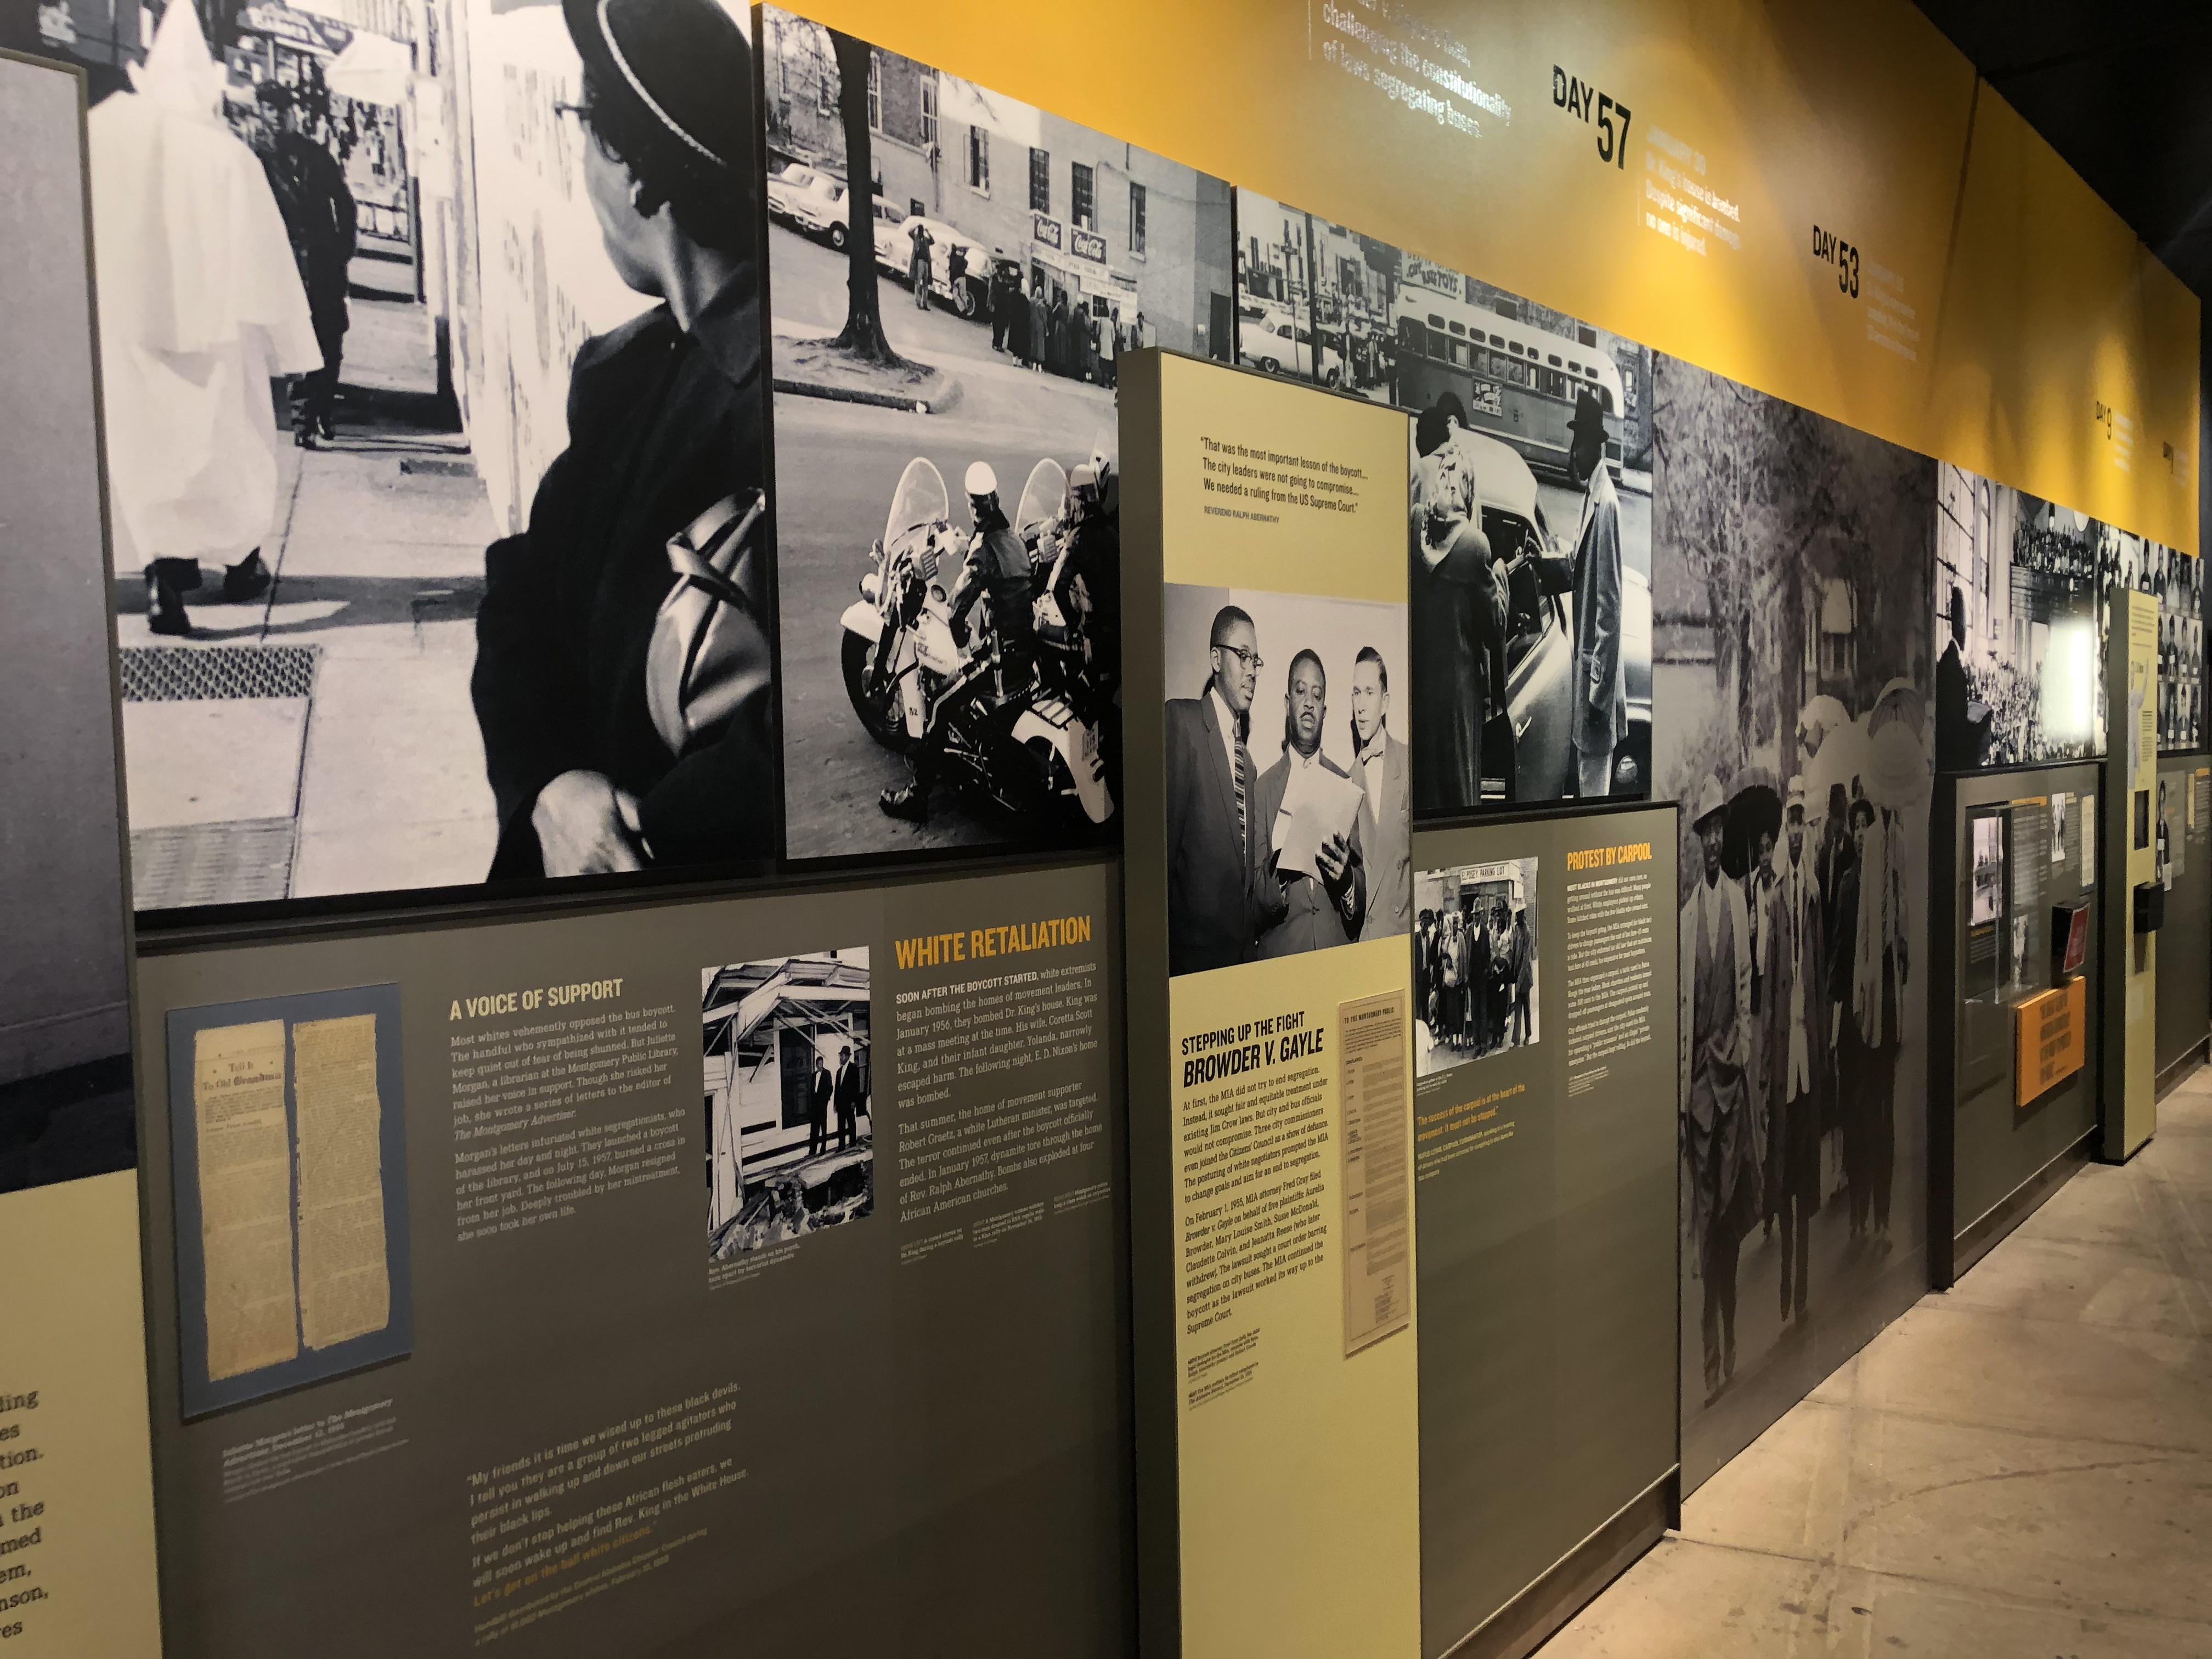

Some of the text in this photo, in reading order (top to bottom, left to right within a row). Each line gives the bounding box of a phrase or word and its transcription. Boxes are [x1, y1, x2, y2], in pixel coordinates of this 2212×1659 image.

[1553, 64, 1594, 123] DAY
[1597, 93, 1631, 170] 57
[1813, 225, 1859, 298] DAY 53
[2107, 407, 2112, 441] 9
[1201, 437, 1220, 452] "That
[1222, 444, 1235, 455] was
[1237, 444, 1248, 458] the
[1250, 449, 1266, 460] most
[1268, 451, 1299, 466] important
[1301, 456, 1320, 470] lesson
[1322, 461, 1328, 472] of
[1329, 462, 1339, 474] the
[1204, 457, 1216, 471] The
[1218, 463, 1231, 476] city
[1233, 462, 1257, 478] leaders
[1260, 471, 1275, 482] were
[1278, 474, 1288, 483] not
[1290, 475, 1307, 489] going
[1309, 478, 1314, 488] to
[1204, 477, 1215, 491] We
[1217, 482, 1242, 495] needed
[1244, 487, 1248, 496] a
[1250, 487, 1269, 503] ruling
[1272, 489, 1286, 502] from
[1288, 492, 1297, 504] the
[1300, 493, 1308, 506] US
[1310, 495, 1336, 510] Supreme
[1204, 505, 1279, 523] REVEREND RALPH ABERNATHY
[1567, 842, 1653, 871] PROTEST BY CARPOOL
[896, 915, 1090, 969] WHITE RETALIATION
[449, 978, 623, 1020] A VOICE OF SUPPORT
[896, 991, 919, 1004] SOON
[922, 986, 947, 1000] AFTER
[950, 983, 965, 995] THE
[967, 977, 1002, 992] BOYCOTT
[1041, 969, 1059, 979] white
[1061, 963, 1096, 976] extremists
[897, 978, 1091, 1023] began bombing the homes of movement leaders. In
[451, 1005, 675, 1047] Most whites vehemently opposed the bus boycott.
[1182, 1011, 1305, 1055] STEPPING UP THE FIGHT
[1184, 1044, 1260, 1088] BROWDER
[1265, 1040, 1275, 1065] V.
[1280, 1028, 1323, 1062] GAYLE
[1183, 1101, 1190, 1111] At
[1193, 1097, 1207, 1108] first,
[1209, 1093, 1218, 1103] the
[1221, 1088, 1234, 1101] MIA
[1236, 1085, 1245, 1096] did
[1248, 1083, 1256, 1093] not
[1258, 1081, 1267, 1090] try
[1276, 1074, 1285, 1085] end
[1288, 1067, 1319, 1082] segregation.
[12, 1501, 44, 1523] the
